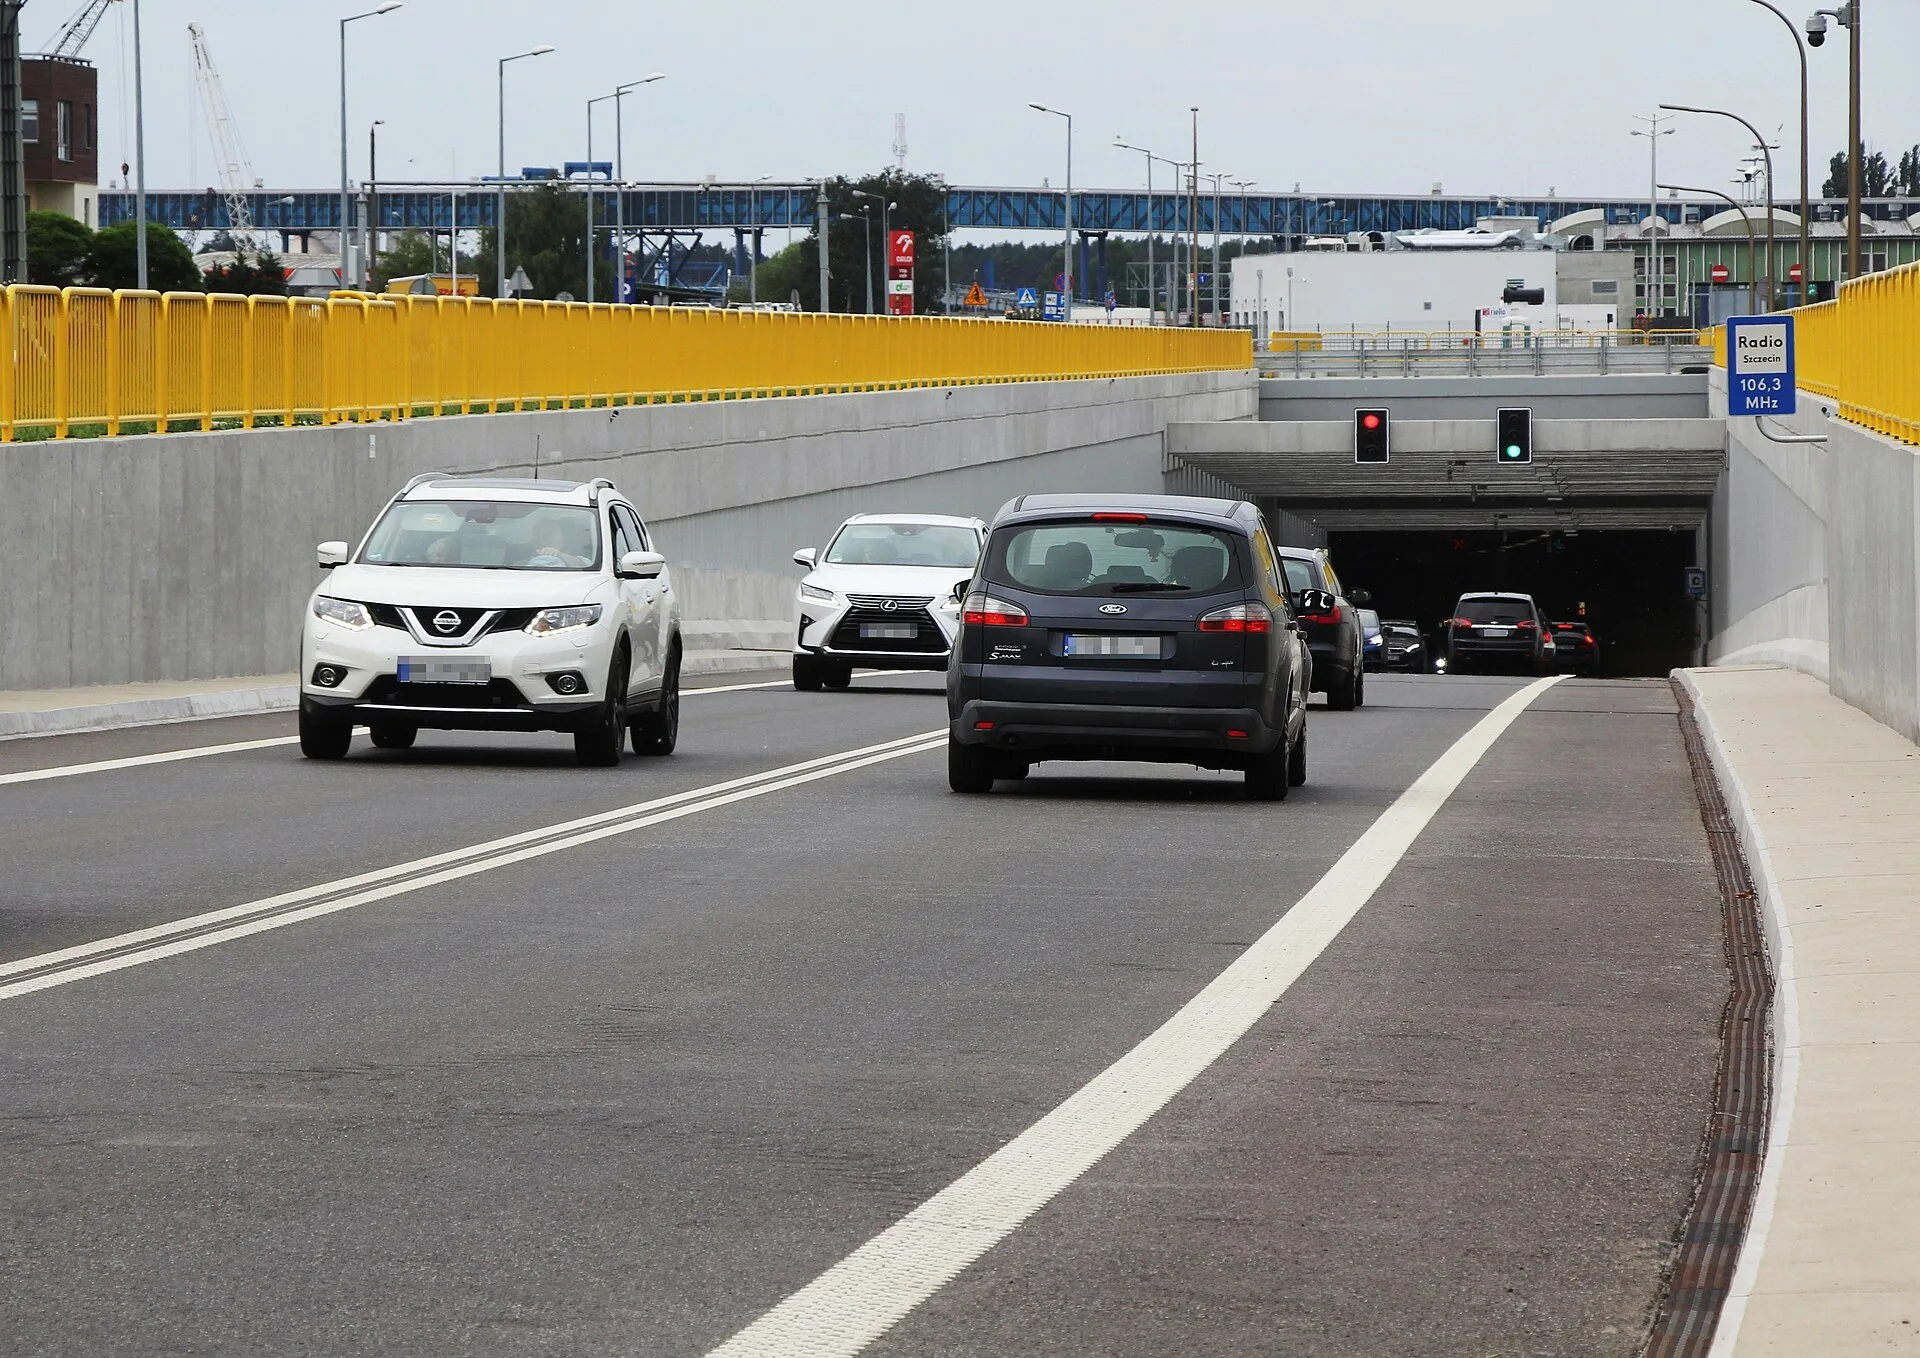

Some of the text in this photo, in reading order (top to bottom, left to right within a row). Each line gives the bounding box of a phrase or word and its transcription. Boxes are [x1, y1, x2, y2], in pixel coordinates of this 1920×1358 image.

[1738, 335, 1783, 349] Radio
[1743, 354, 1781, 363] Szczecin
[1740, 377, 1781, 392] 106,3
[1745, 396, 1778, 409] MHz
